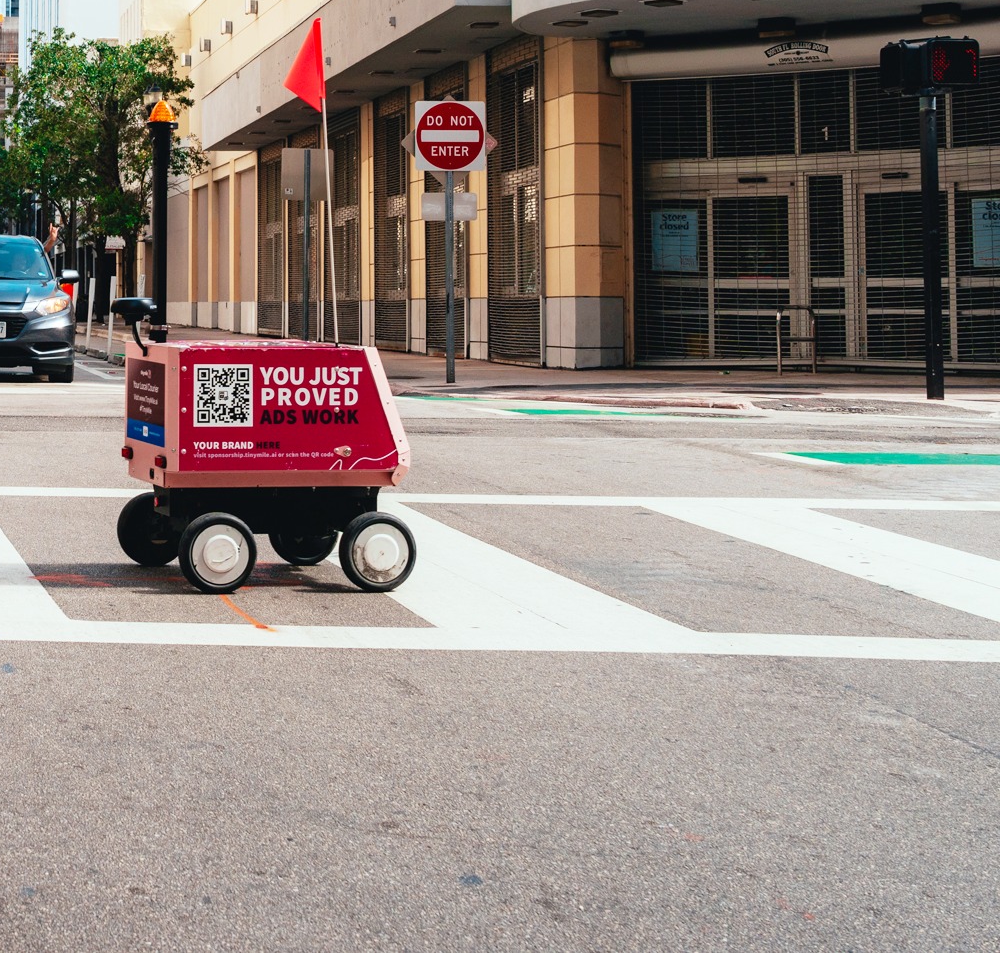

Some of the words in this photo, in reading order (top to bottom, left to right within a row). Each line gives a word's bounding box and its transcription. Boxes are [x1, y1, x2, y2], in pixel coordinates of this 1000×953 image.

[426, 115, 443, 126] DO
[450, 115, 474, 126] NOT
[431, 146, 469, 157] ENTER
[662, 213, 687, 221] Store
[660, 222, 689, 230] closed
[260, 367, 304, 385] YOU
[309, 366, 363, 385] JUST
[261, 387, 359, 406] PROVED
[260, 409, 297, 424] ADS
[302, 409, 359, 424] WORK
[193, 441, 220, 450] YOUR
[221, 441, 254, 450] BRAND
[256, 441, 280, 449] HERE
